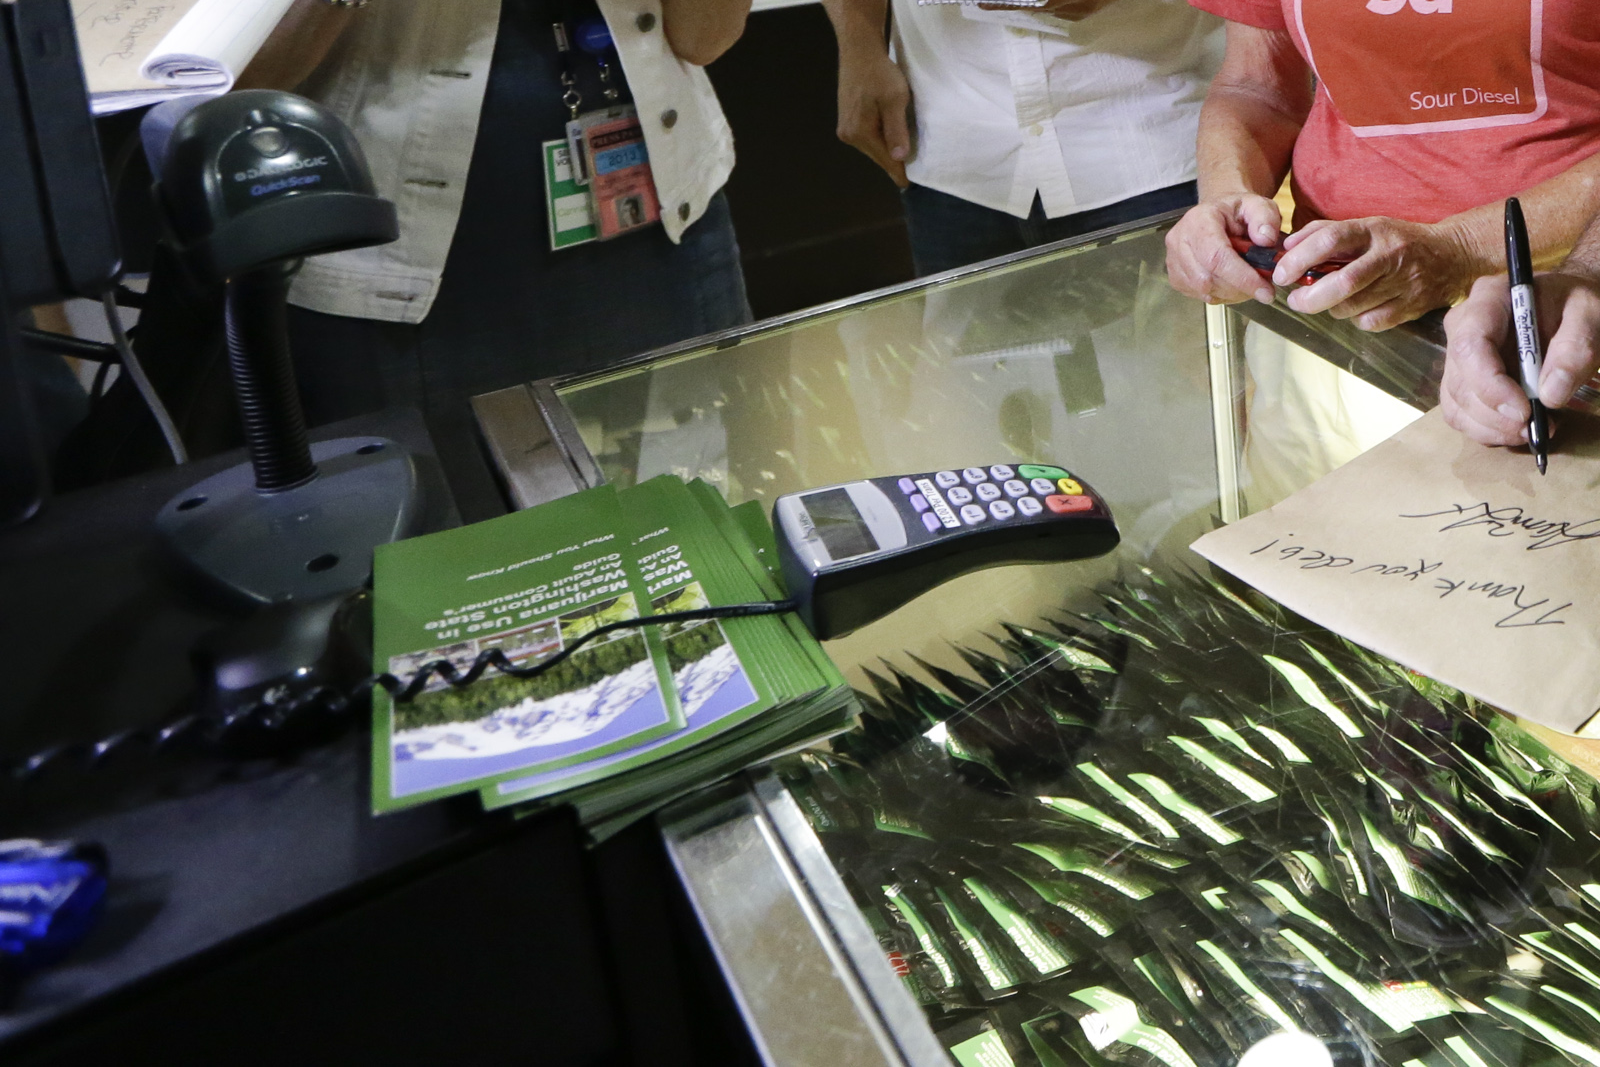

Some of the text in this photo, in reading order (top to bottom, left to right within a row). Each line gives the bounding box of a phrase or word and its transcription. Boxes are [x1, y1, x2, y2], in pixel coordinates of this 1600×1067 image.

[1409, 86, 1520, 110] Sour Diesel
[251, 174, 321, 196] QuickScan
[920, 482, 935, 498] Trans
[932, 498, 946, 508] Per
[939, 507, 955, 524] $2.00
[466, 534, 615, 581] What You Should Know
[572, 552, 621, 571] Guide
[660, 552, 682, 564] An
[1354, 558, 1443, 581] you
[443, 560, 623, 616] An Adult Consumer's
[424, 569, 626, 631] Washington State
[437, 578, 629, 640] Marijuana Use in
[1434, 577, 1573, 628] Thank
[1074, 910, 1091, 922] OG
[930, 952, 946, 964] OG
[967, 937, 983, 960] Kush
[1006, 926, 1050, 974] Opal OG Kush
[981, 962, 1001, 987] Opal
